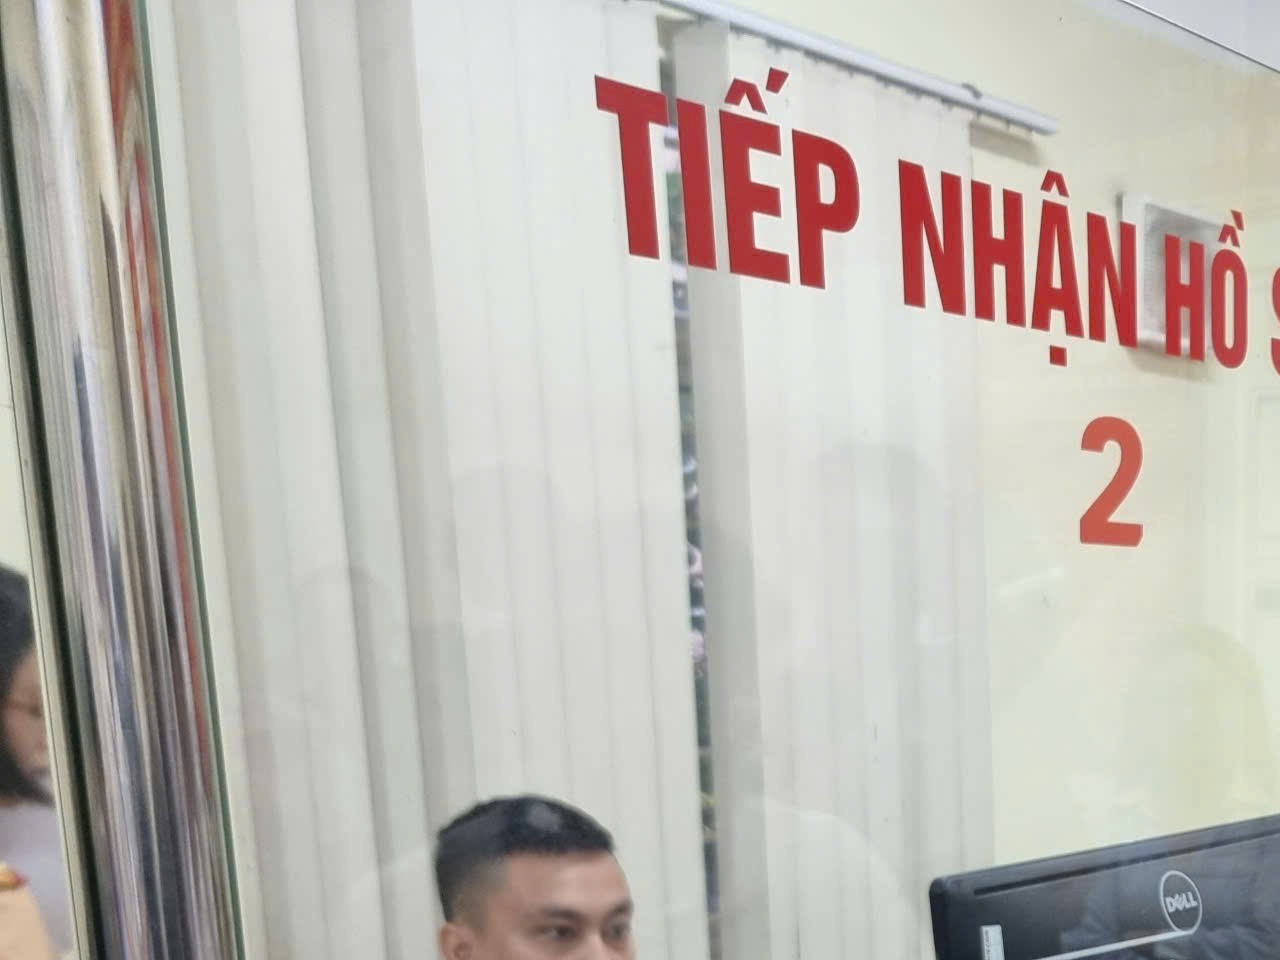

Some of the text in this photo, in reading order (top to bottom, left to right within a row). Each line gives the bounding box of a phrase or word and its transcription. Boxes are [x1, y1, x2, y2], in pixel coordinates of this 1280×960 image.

[594, 67, 860, 289] TIẾP
[899, 169, 1138, 367] NHẬN
[1164, 209, 1248, 369] HỒ
[1079, 415, 1143, 547] 2
[1165, 891, 1198, 913] DELL
